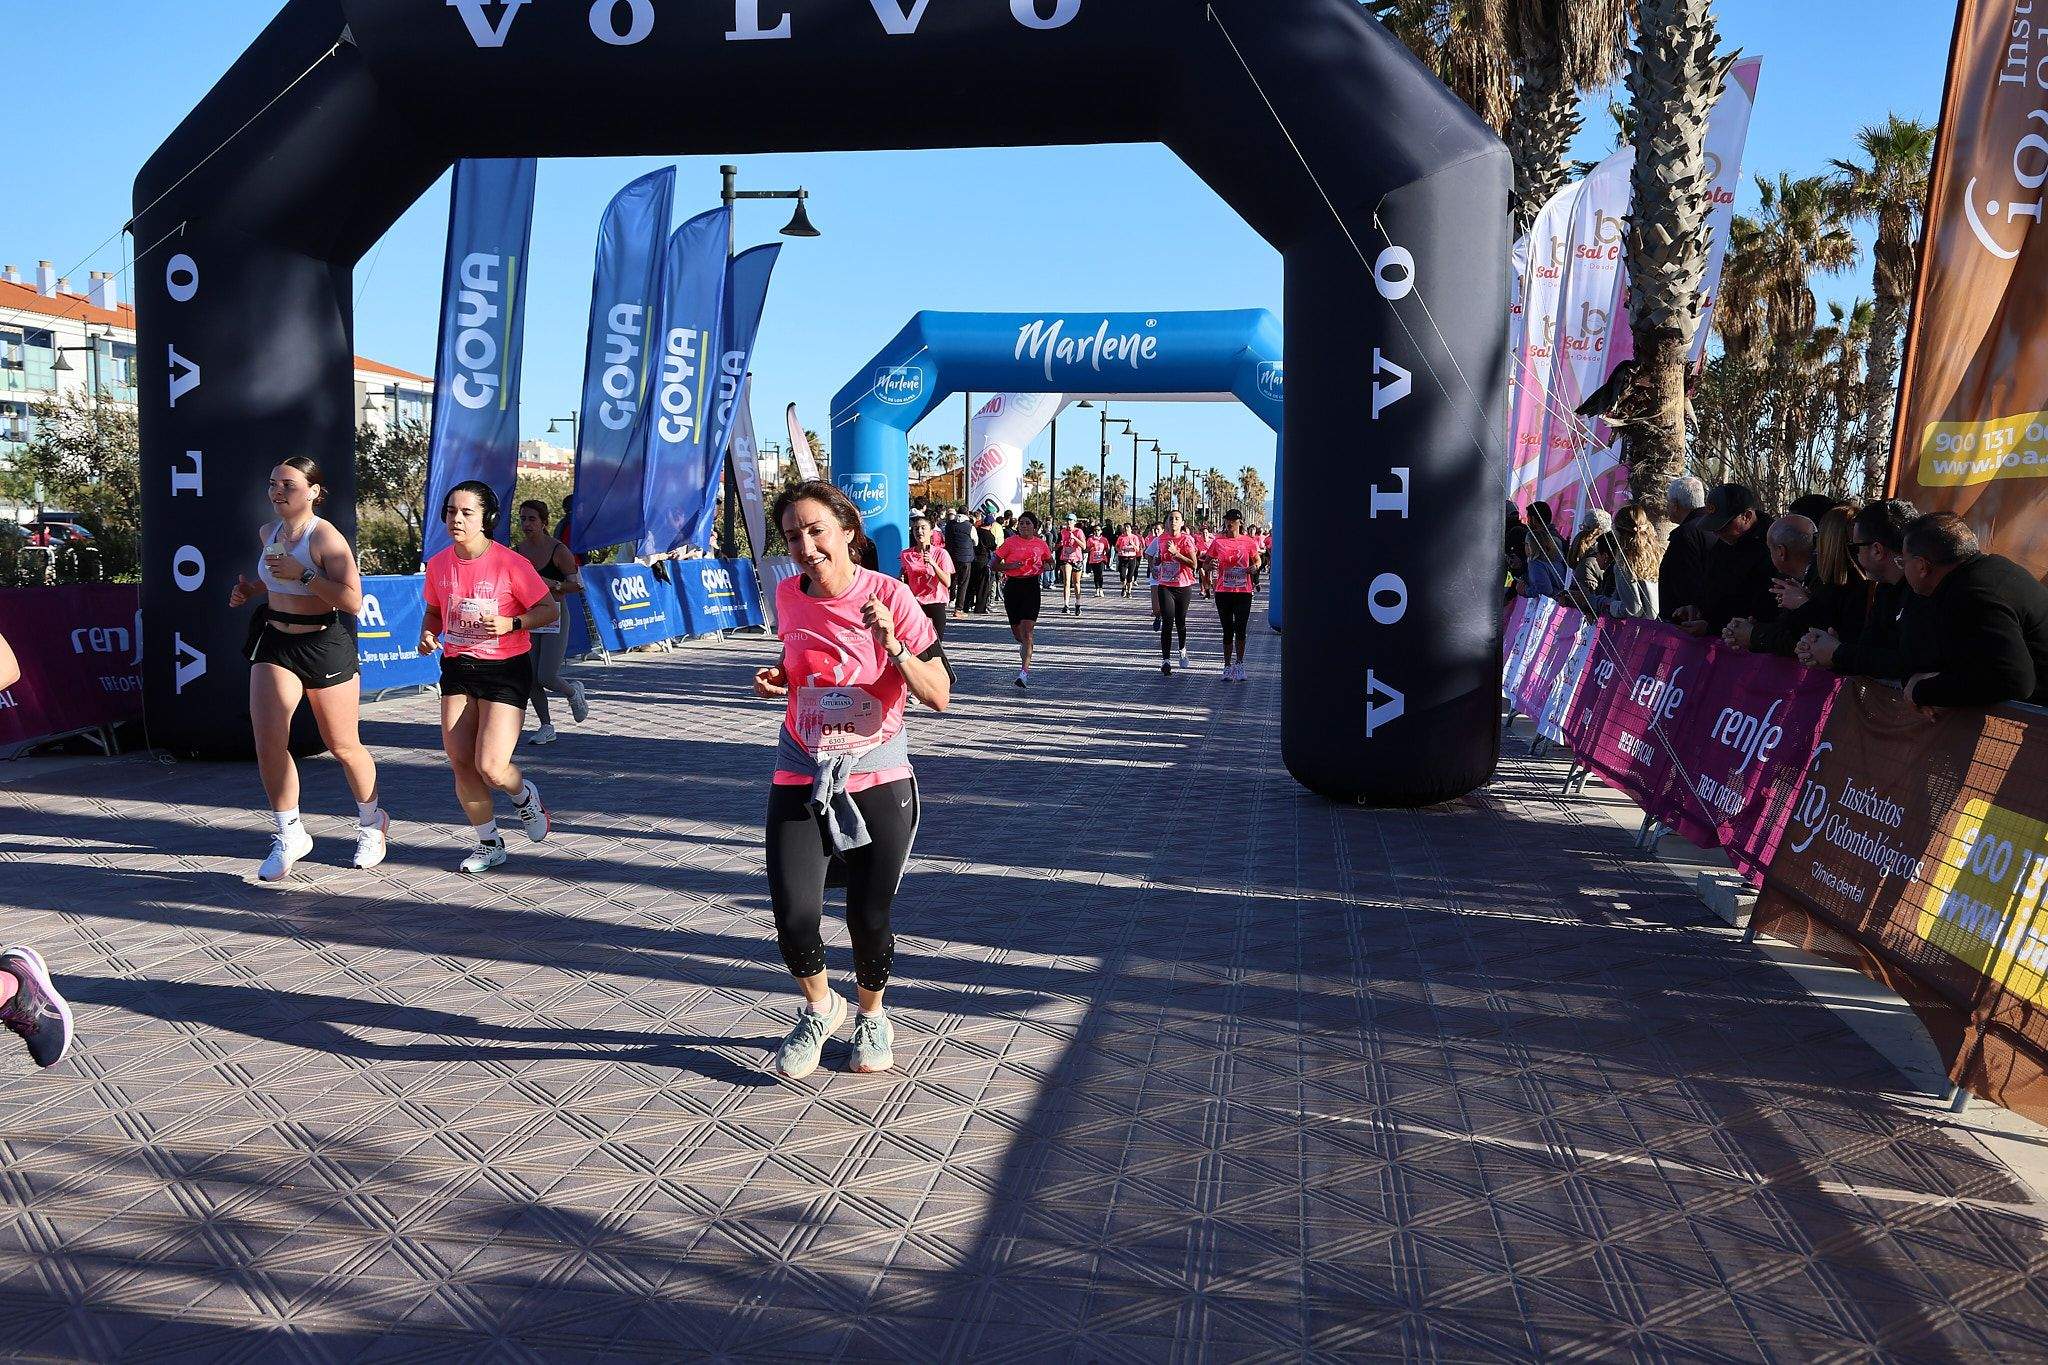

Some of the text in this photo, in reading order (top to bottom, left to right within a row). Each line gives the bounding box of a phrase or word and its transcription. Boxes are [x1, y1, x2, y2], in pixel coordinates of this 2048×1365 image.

[1537, 266, 1560, 279] Sal
[1576, 245, 1603, 260] Sal
[452, 252, 500, 409] GOYA
[1530, 345, 1552, 358] Sal
[600, 303, 643, 430] GOYA
[658, 327, 697, 443] GOYA
[1935, 431, 1977, 454] 900
[1983, 427, 2015, 451] 131
[166, 253, 207, 694] VOLVO
[1366, 246, 1415, 738] VOLVO
[611, 575, 650, 604] GOYA
[702, 568, 733, 593] GOYA
[1630, 665, 1684, 731] renfe
[821, 721, 856, 736] 016
[1710, 699, 1783, 775] renfe
[1697, 773, 1747, 816] TREN OFICIAL
[1837, 777, 1905, 829] Institutos
[1825, 813, 1925, 884] Odontológicos
[1956, 826, 2014, 885] 900
[1811, 860, 1866, 904] Clínica dental
